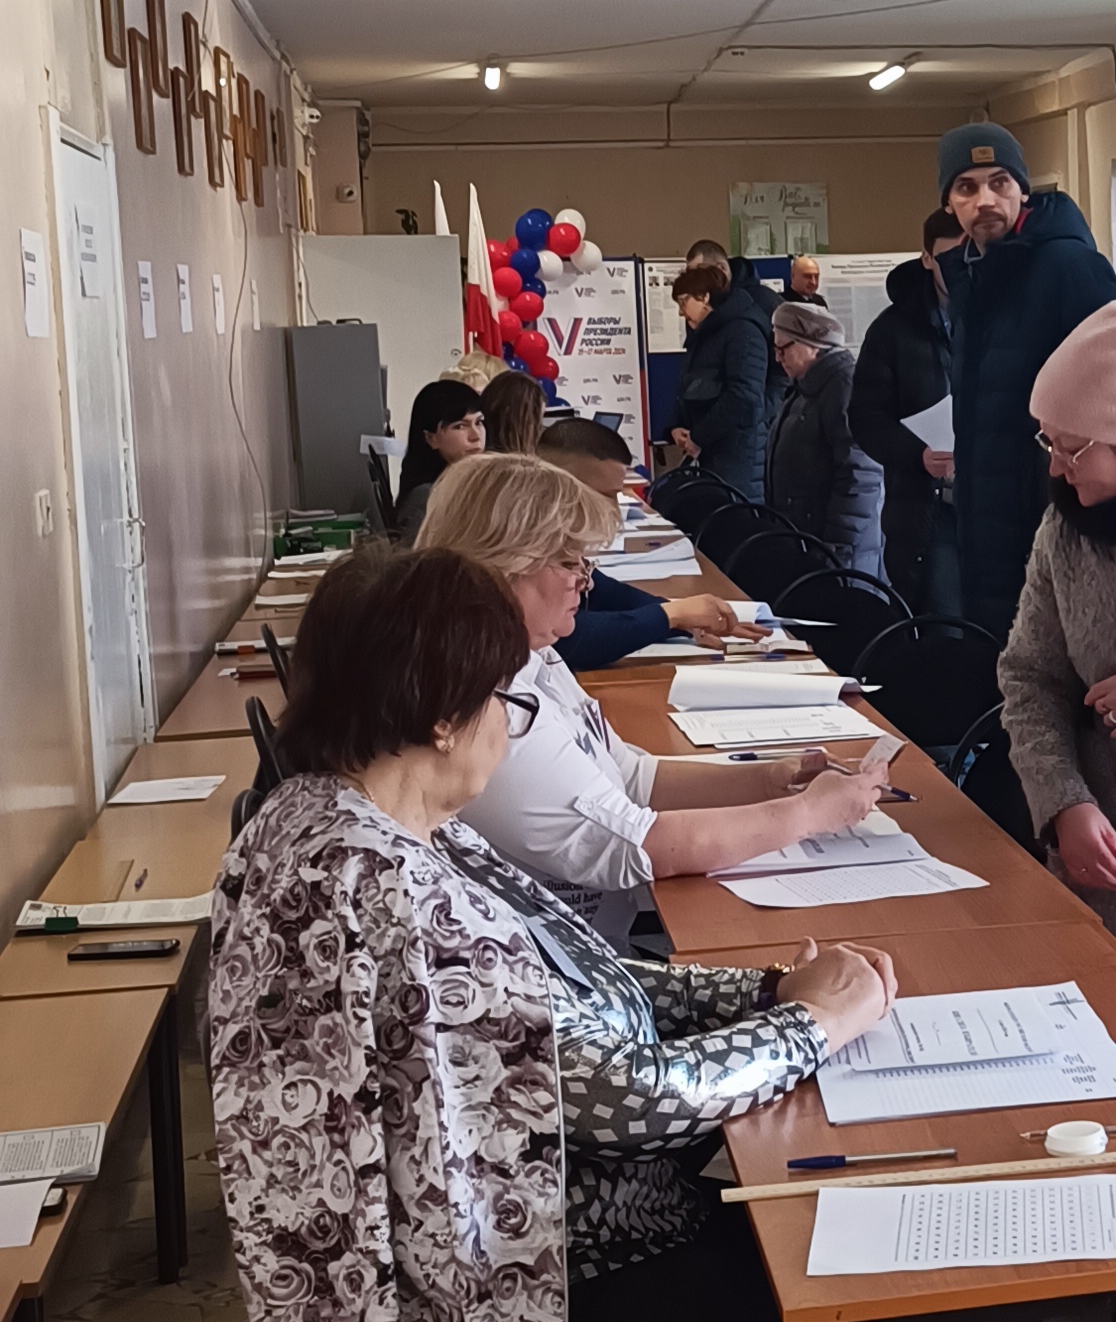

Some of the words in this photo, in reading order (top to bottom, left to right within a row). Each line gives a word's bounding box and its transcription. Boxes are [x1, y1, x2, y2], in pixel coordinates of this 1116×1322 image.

[587, 317, 621, 325] ВЫБОРЫ
[583, 327, 632, 336] ПРЕЗИДЕНТА
[580, 338, 612, 347] РОССИИ
[583, 892, 603, 903] have
